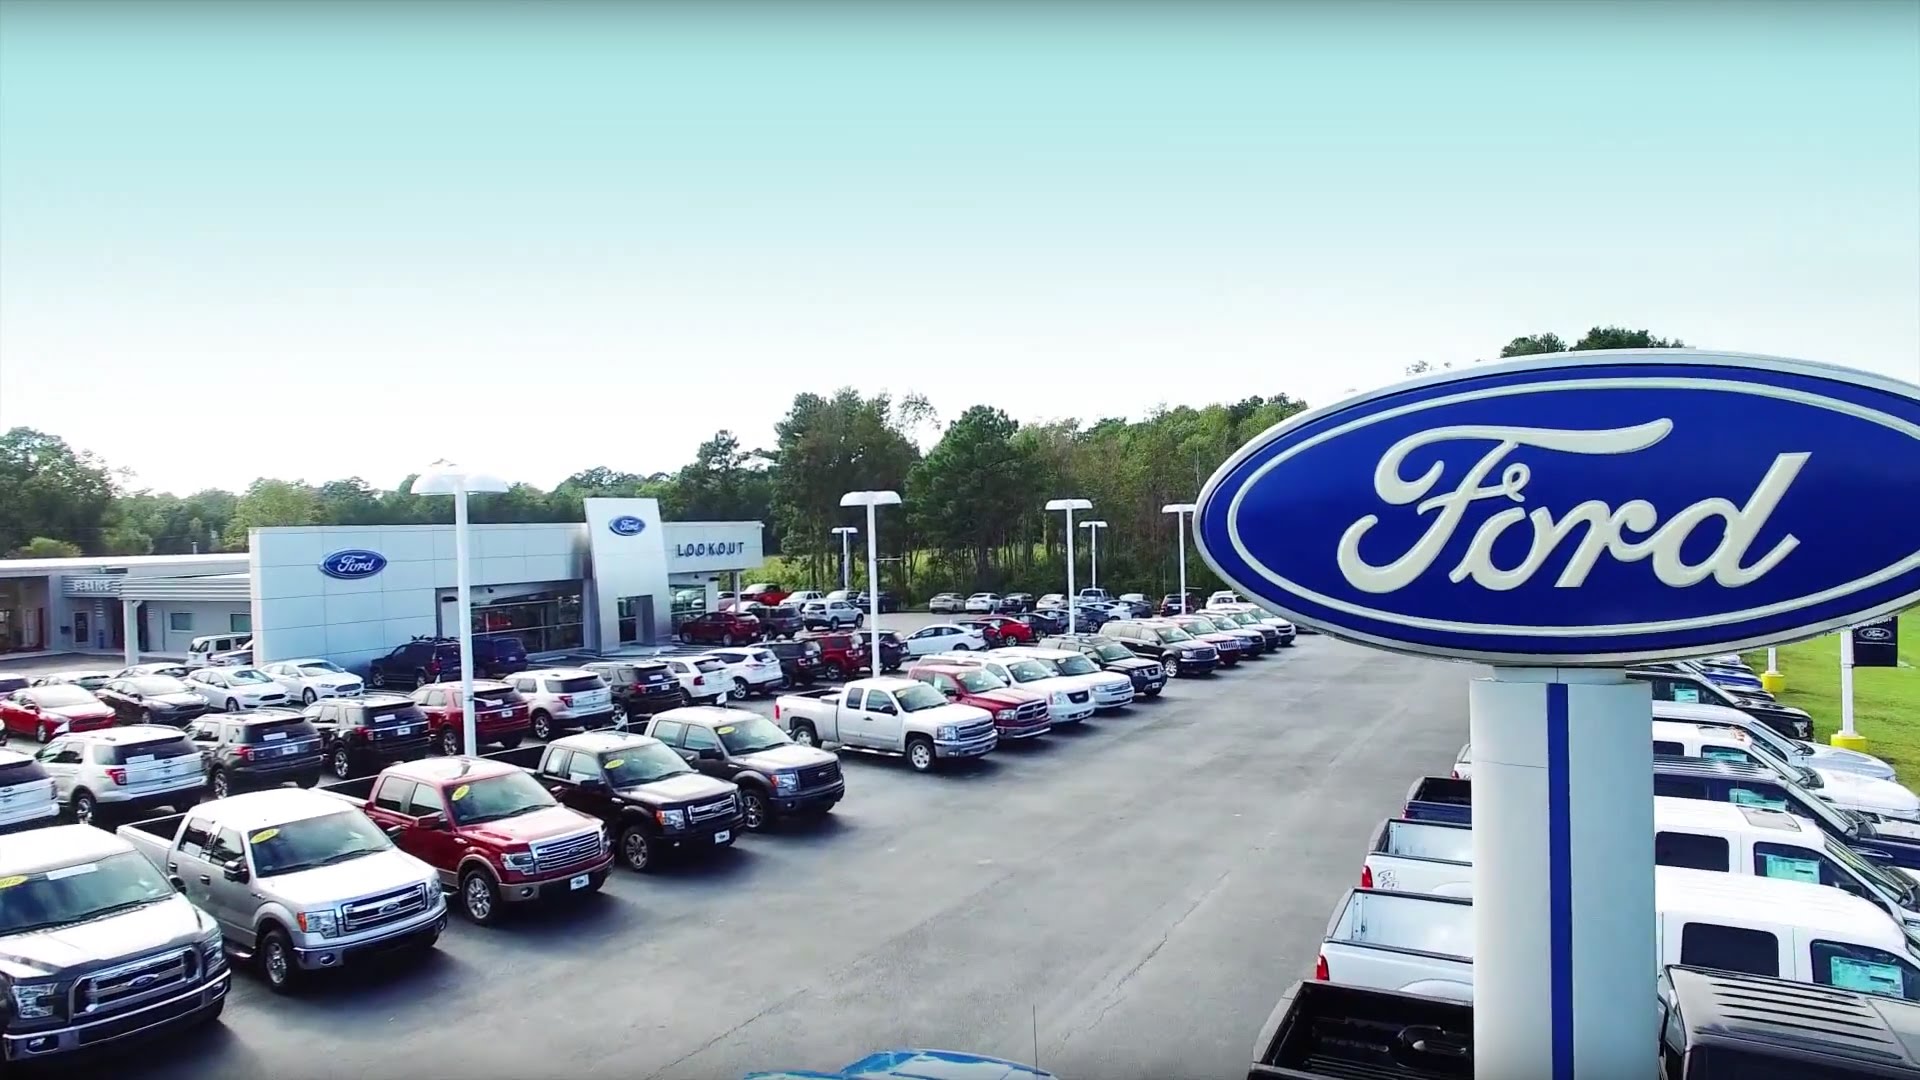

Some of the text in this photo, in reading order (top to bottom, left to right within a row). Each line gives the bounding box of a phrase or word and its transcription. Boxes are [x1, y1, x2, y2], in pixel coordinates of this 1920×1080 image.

[1337, 417, 1812, 593] Ford
[677, 542, 744, 557] LOOKOUT
[337, 554, 375, 572] Ford
